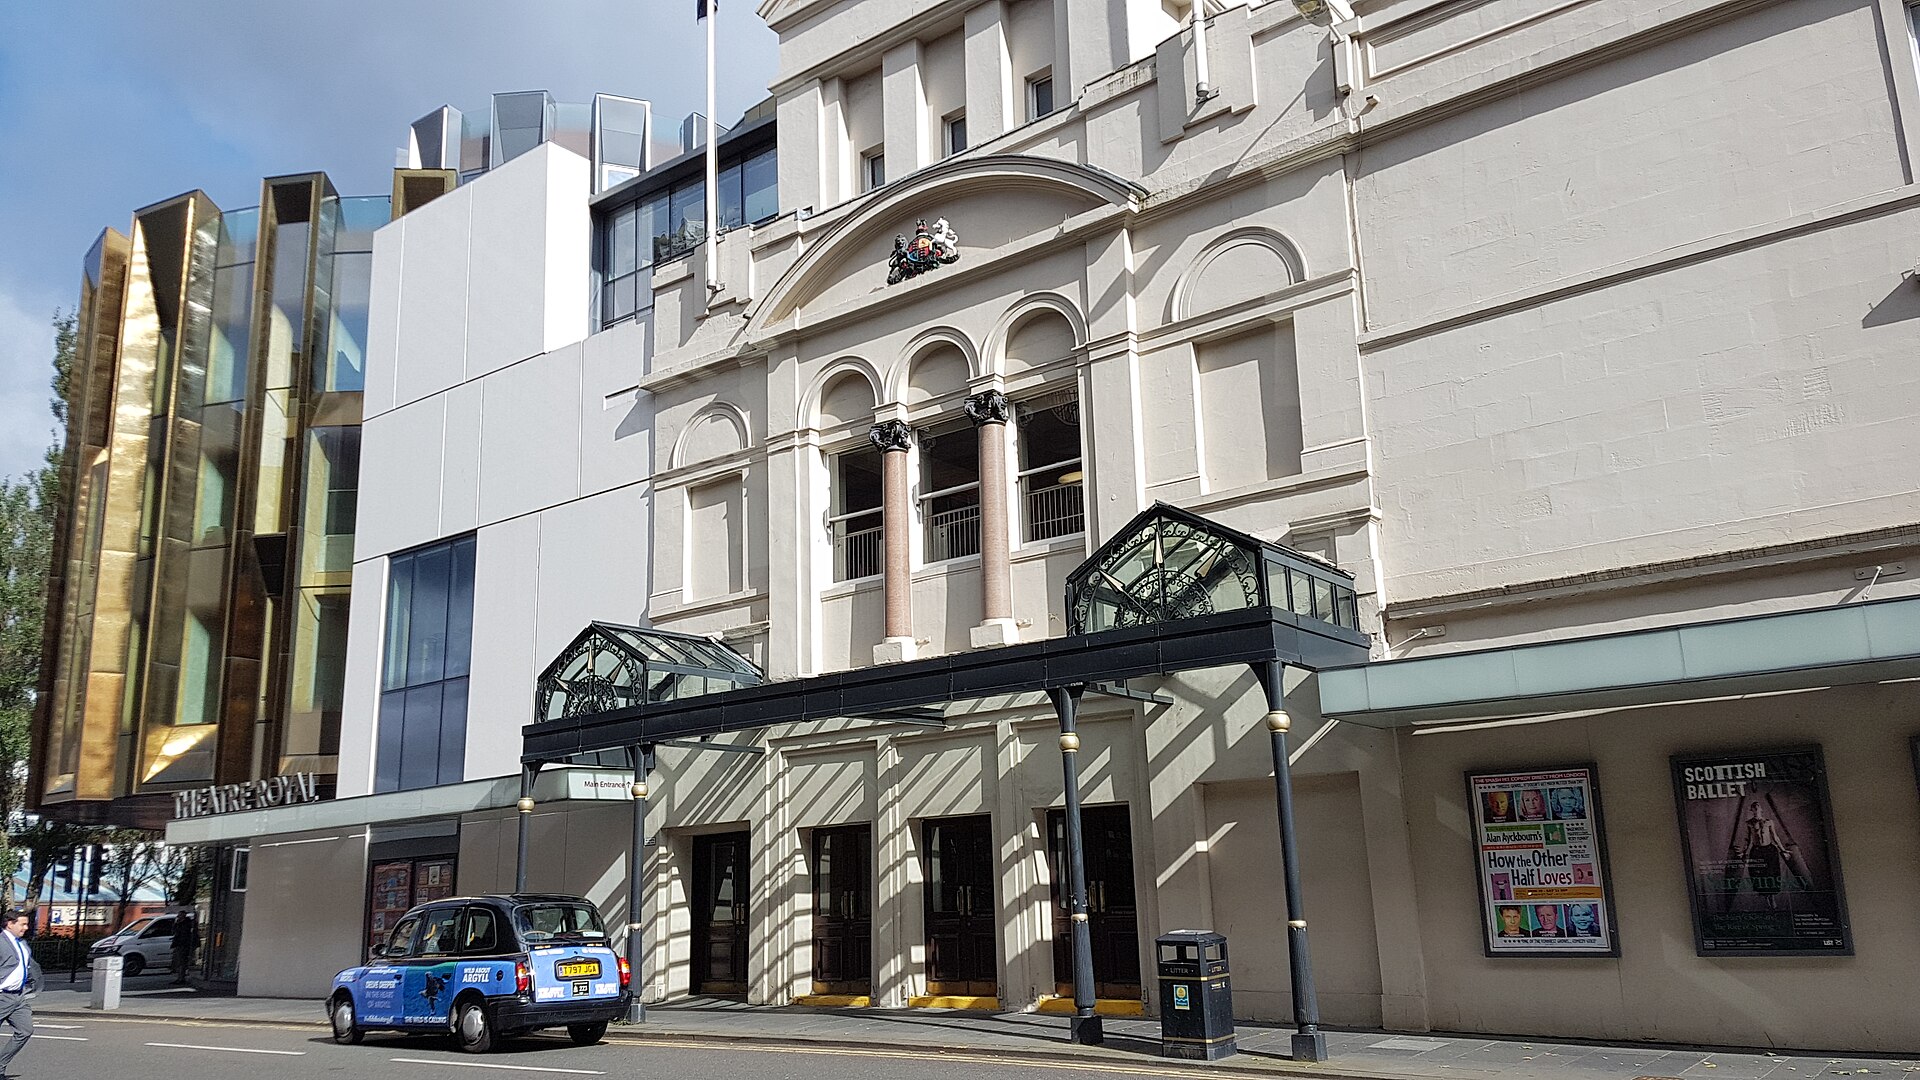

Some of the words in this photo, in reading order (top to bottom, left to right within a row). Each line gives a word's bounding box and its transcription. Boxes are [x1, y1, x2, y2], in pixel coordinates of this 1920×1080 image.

[1684, 763, 1767, 782] SCOTTISH
[173, 781, 253, 819] THEATRE
[255, 771, 320, 809] ROYAL
[1687, 782, 1746, 800] BALLET
[1486, 832, 1502, 842] Alan
[1502, 831, 1543, 844] Ayckbourn's
[1488, 851, 1516, 868] How
[1516, 855, 1532, 867] the
[1532, 849, 1568, 867] Other
[1511, 868, 1535, 886] Half
[1537, 868, 1572, 886] Loves
[462, 973, 489, 983] ARGYLL
[563, 965, 582, 975] T797
[584, 965, 597, 973] JGA
